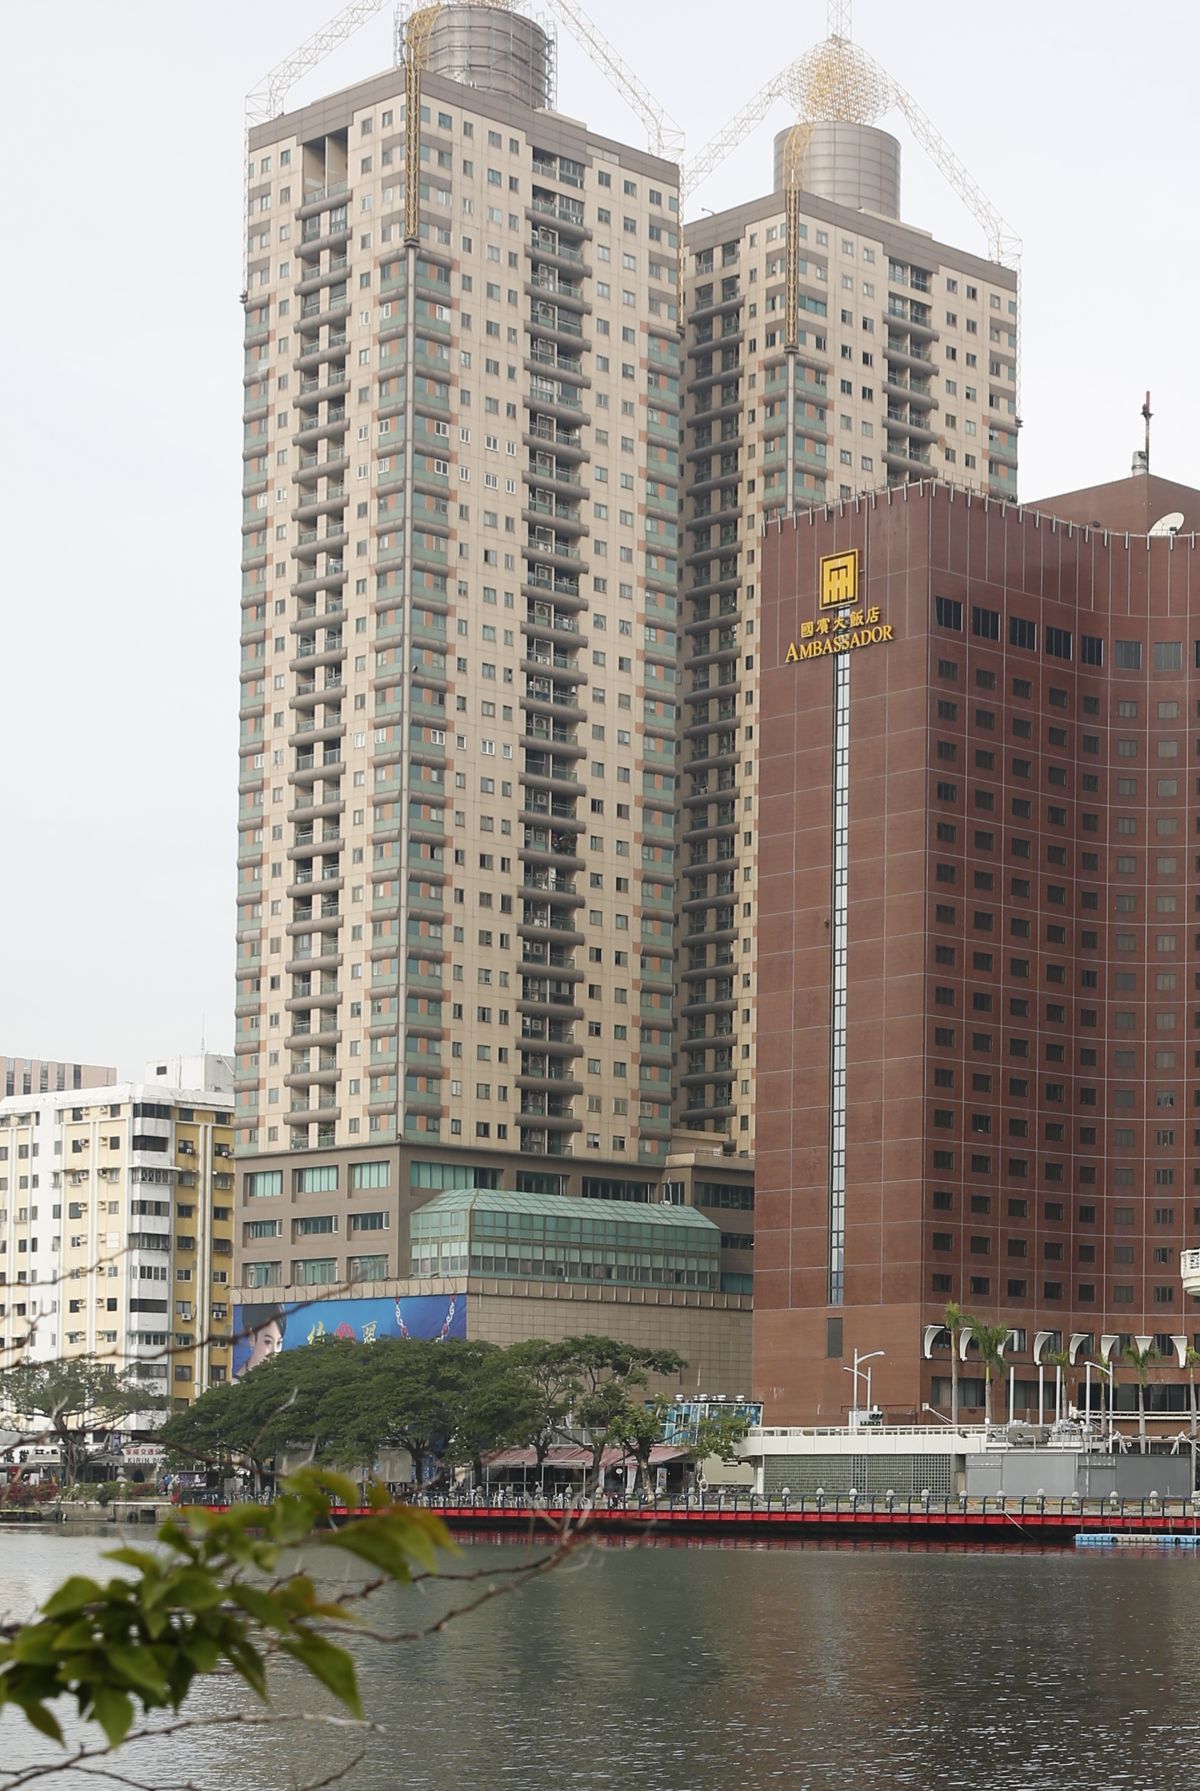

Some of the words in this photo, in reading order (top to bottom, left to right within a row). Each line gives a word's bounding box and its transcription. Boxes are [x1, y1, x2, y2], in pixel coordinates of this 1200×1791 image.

[800, 606, 880, 639] 國賓大飯店
[784, 624, 894, 663] AMBASSADOR
